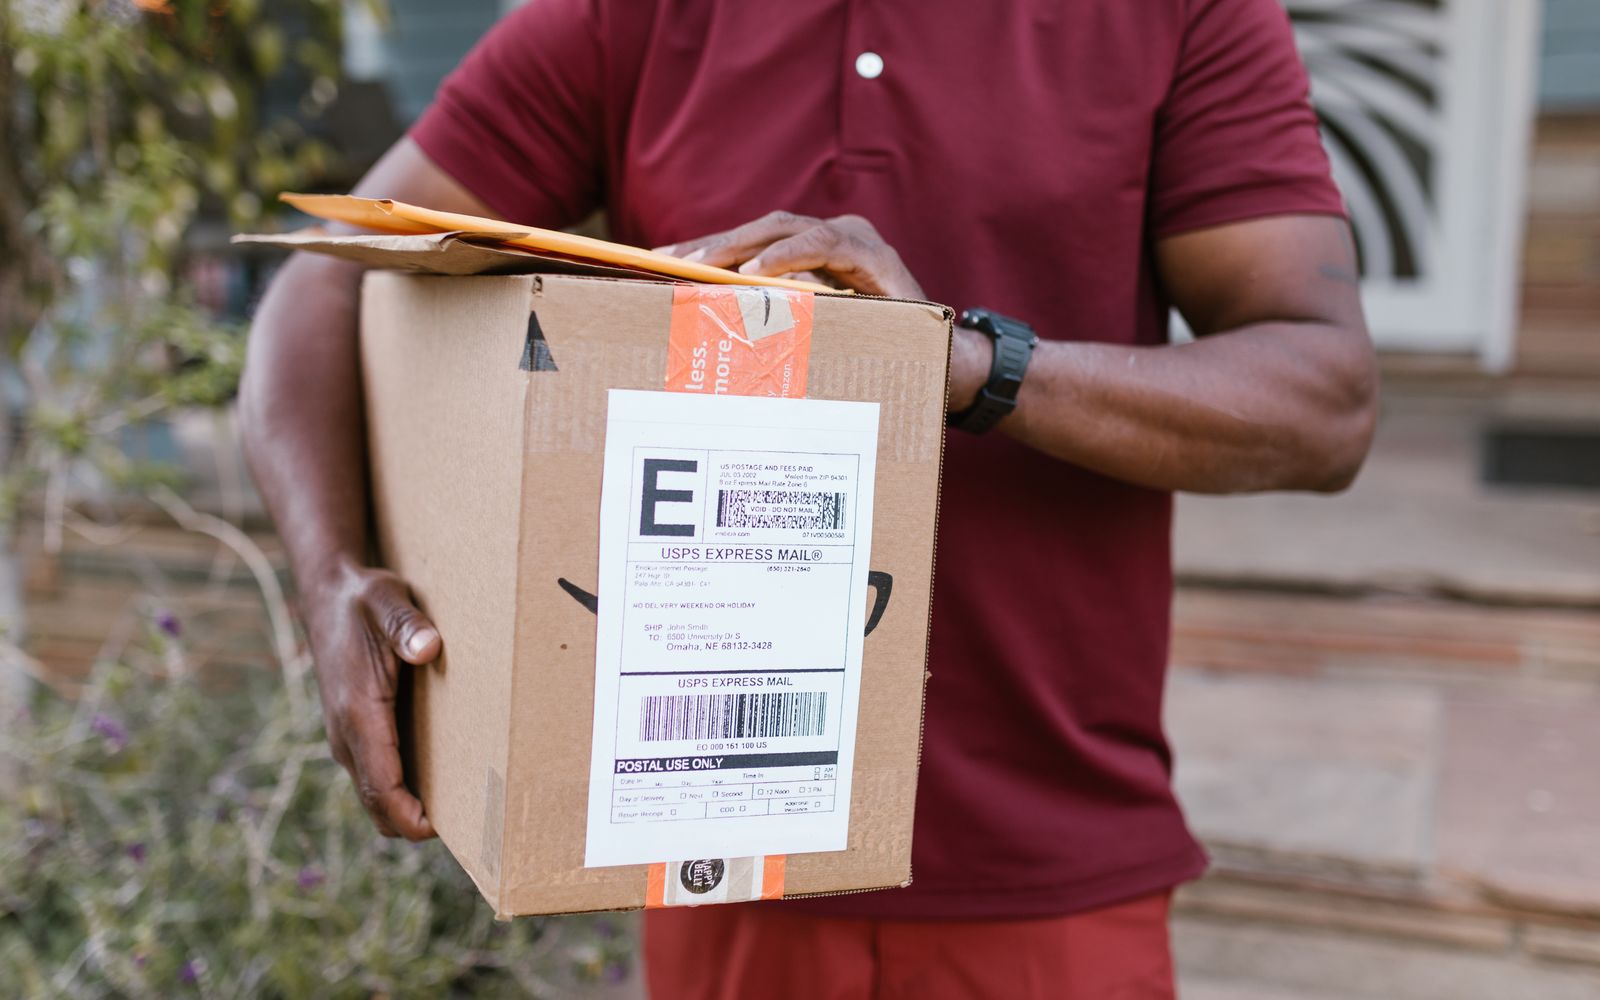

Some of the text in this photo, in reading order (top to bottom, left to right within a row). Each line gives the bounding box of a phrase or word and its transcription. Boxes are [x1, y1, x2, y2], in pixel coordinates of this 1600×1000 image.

[685, 341, 707, 390] less.
[640, 458, 698, 537] E
[661, 547, 701, 560] USPS
[705, 548, 773, 561] EXPRESS
[667, 623, 709, 631] John Smith
[667, 633, 686, 641] 6500
[687, 633, 723, 642] University
[735, 632, 741, 640] S
[704, 642, 718, 650] NE
[721, 641, 773, 650] 68132-3428
[678, 677, 793, 689] USPS EXPRESS MAIL
[726, 742, 739, 750] 161
[741, 742, 755, 750] 100
[756, 741, 768, 749] US
[616, 757, 724, 773] POSTAL USE ONLY
[693, 863, 703, 886] BELLY
[702, 859, 714, 885] HAPPY
